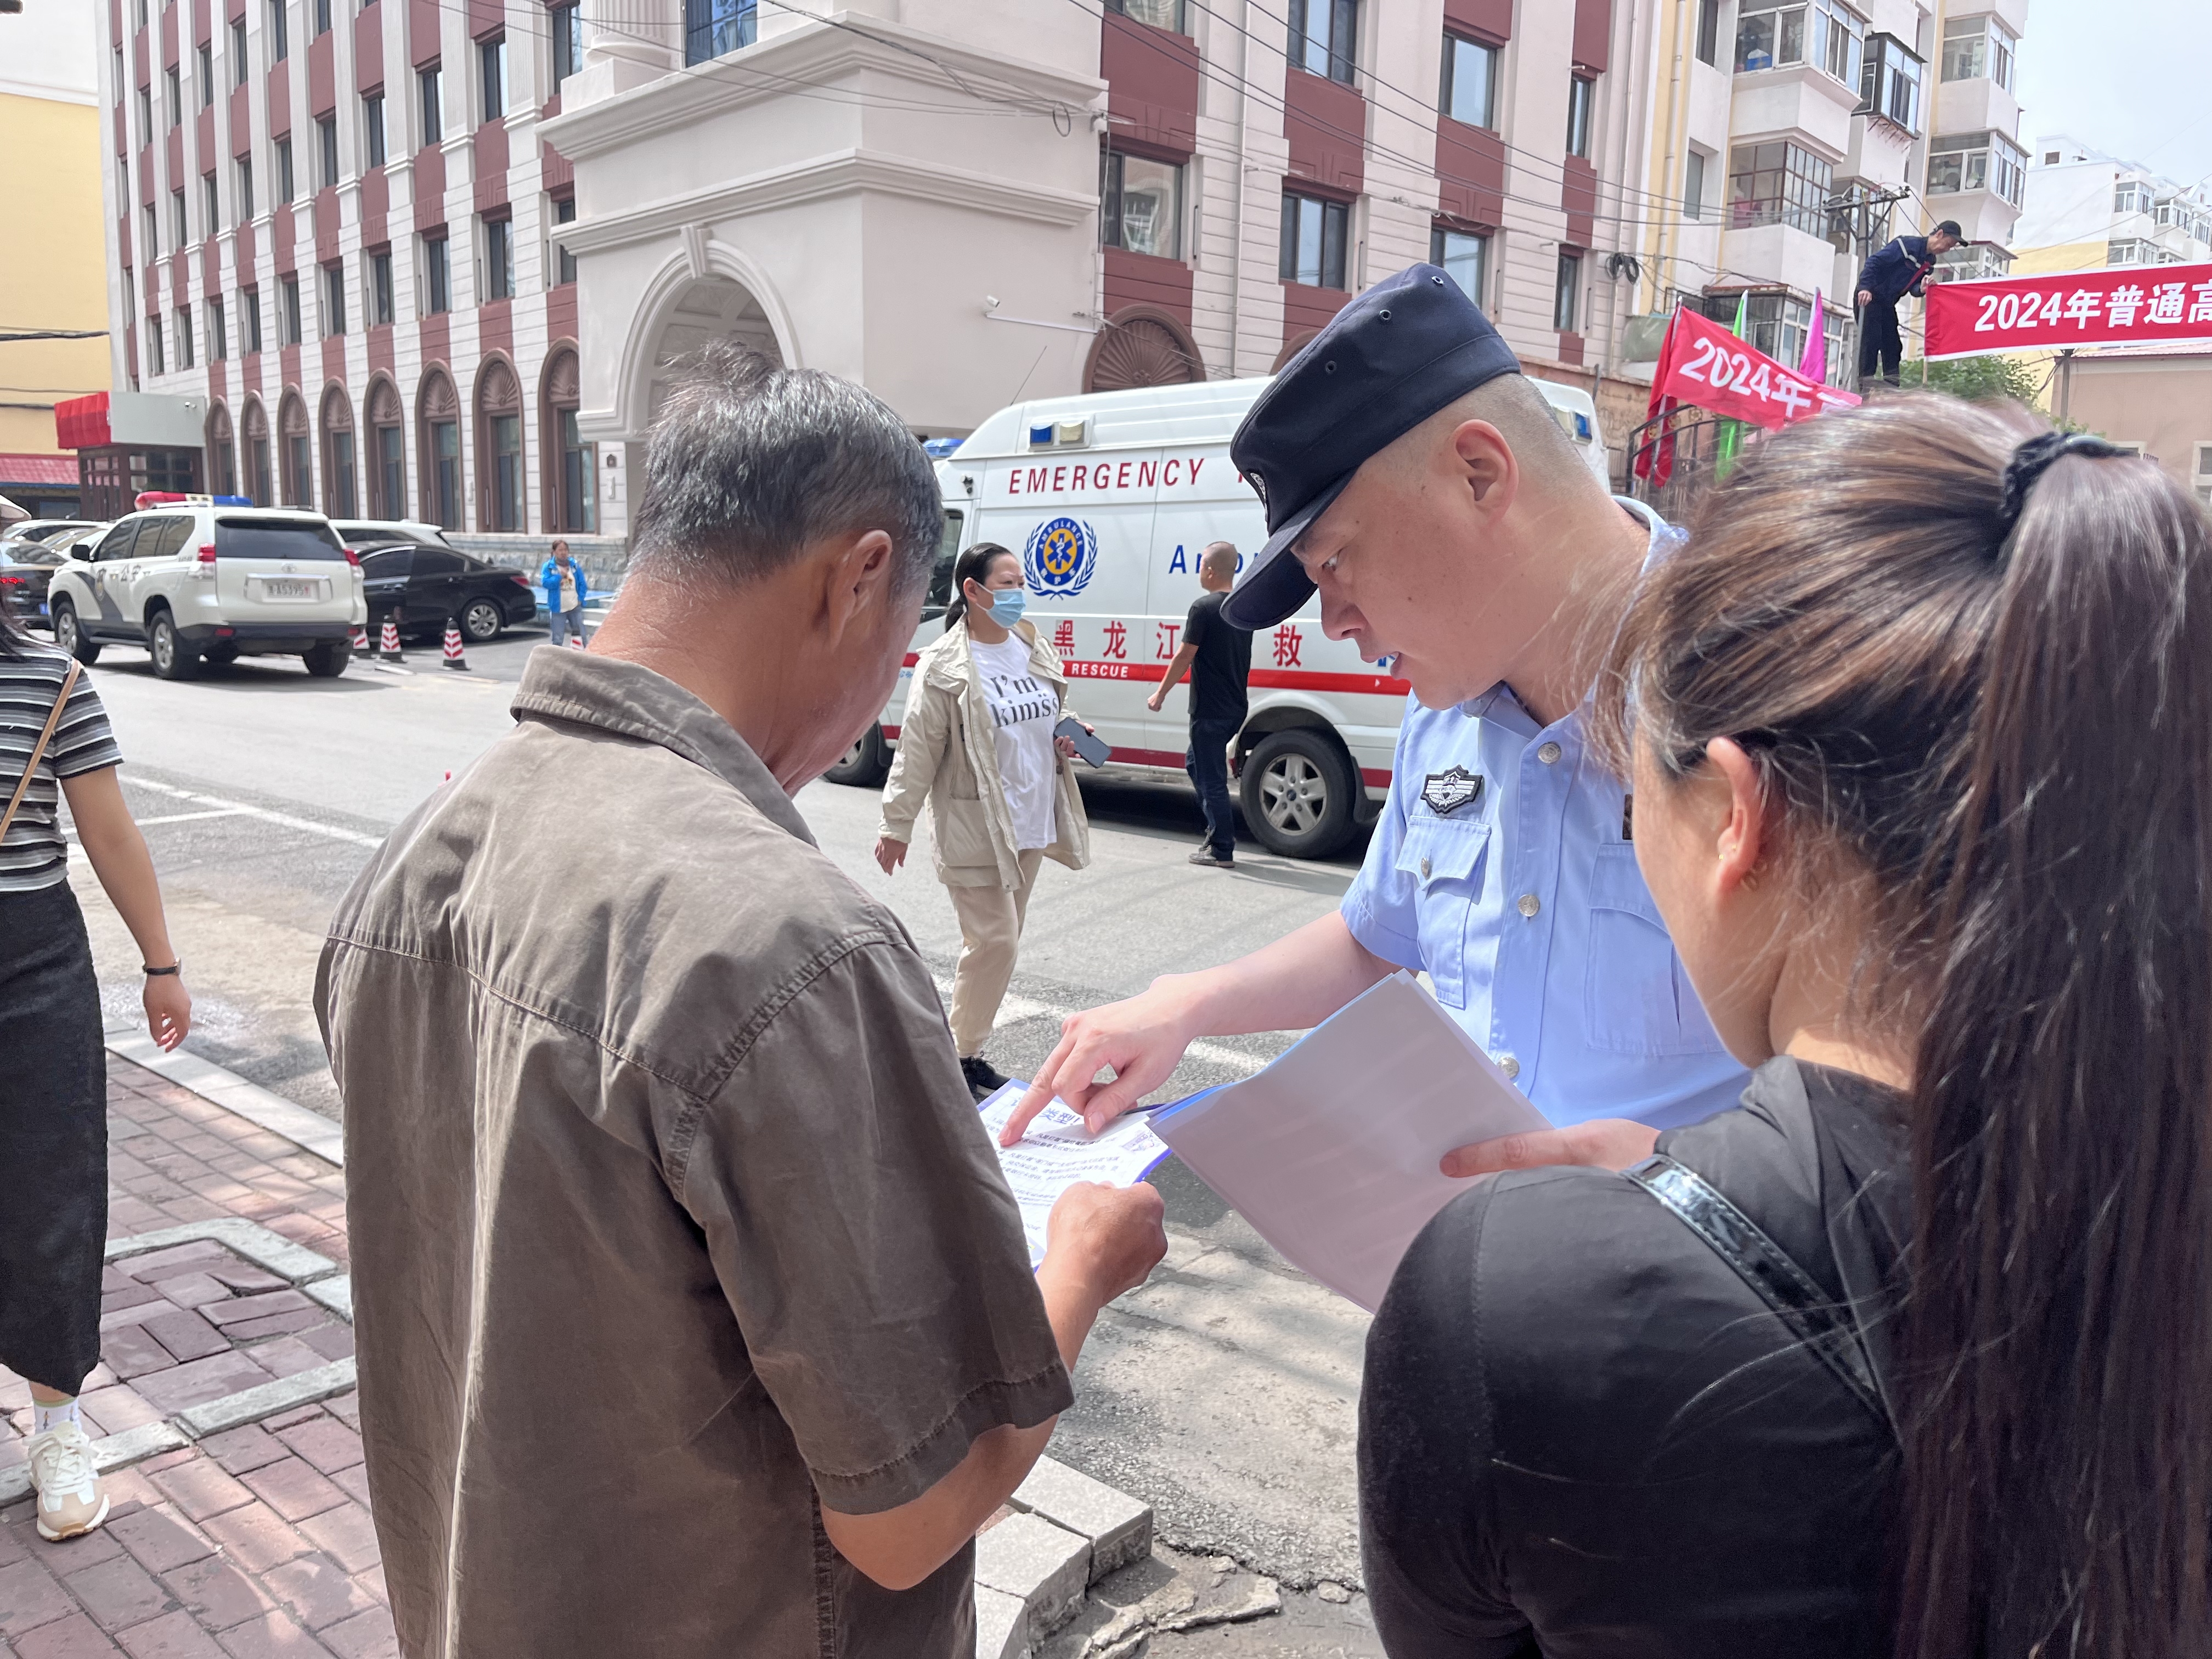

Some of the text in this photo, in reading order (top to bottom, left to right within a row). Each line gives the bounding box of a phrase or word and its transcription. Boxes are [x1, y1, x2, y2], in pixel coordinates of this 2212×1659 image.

[1009, 458, 1205, 494] EMERGENCY
[1039, 521, 1084, 550] AMBULANCE
[1071, 663, 1128, 678] RESCUE
[990, 674, 1041, 698] I'm
